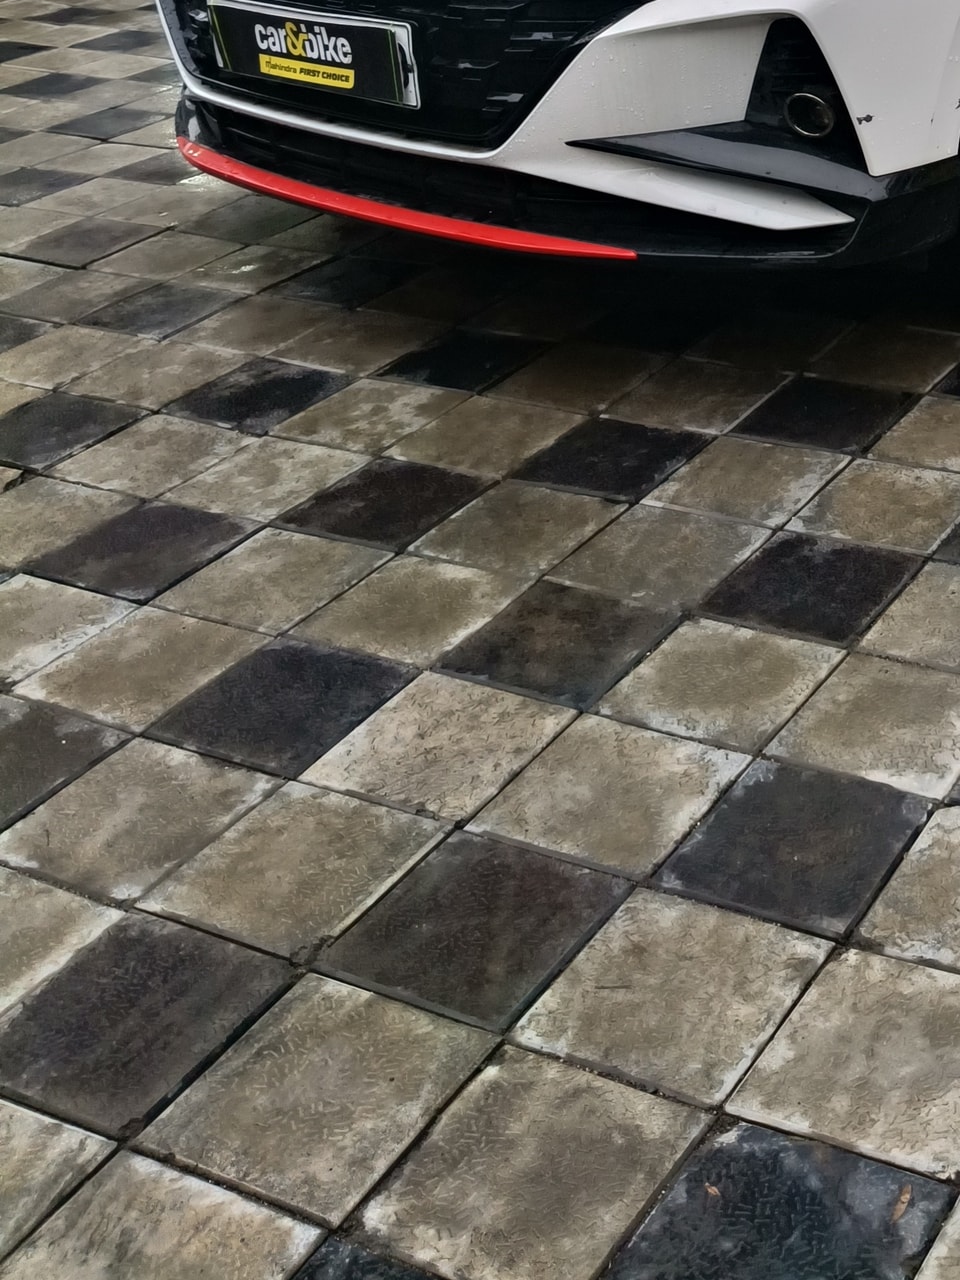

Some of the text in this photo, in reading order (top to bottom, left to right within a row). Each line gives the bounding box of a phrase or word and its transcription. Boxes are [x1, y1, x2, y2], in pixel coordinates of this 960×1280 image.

[254, 21, 353, 65] car&bike
[299, 66, 321, 78] FIRST
[321, 71, 350, 83] CHOICE
